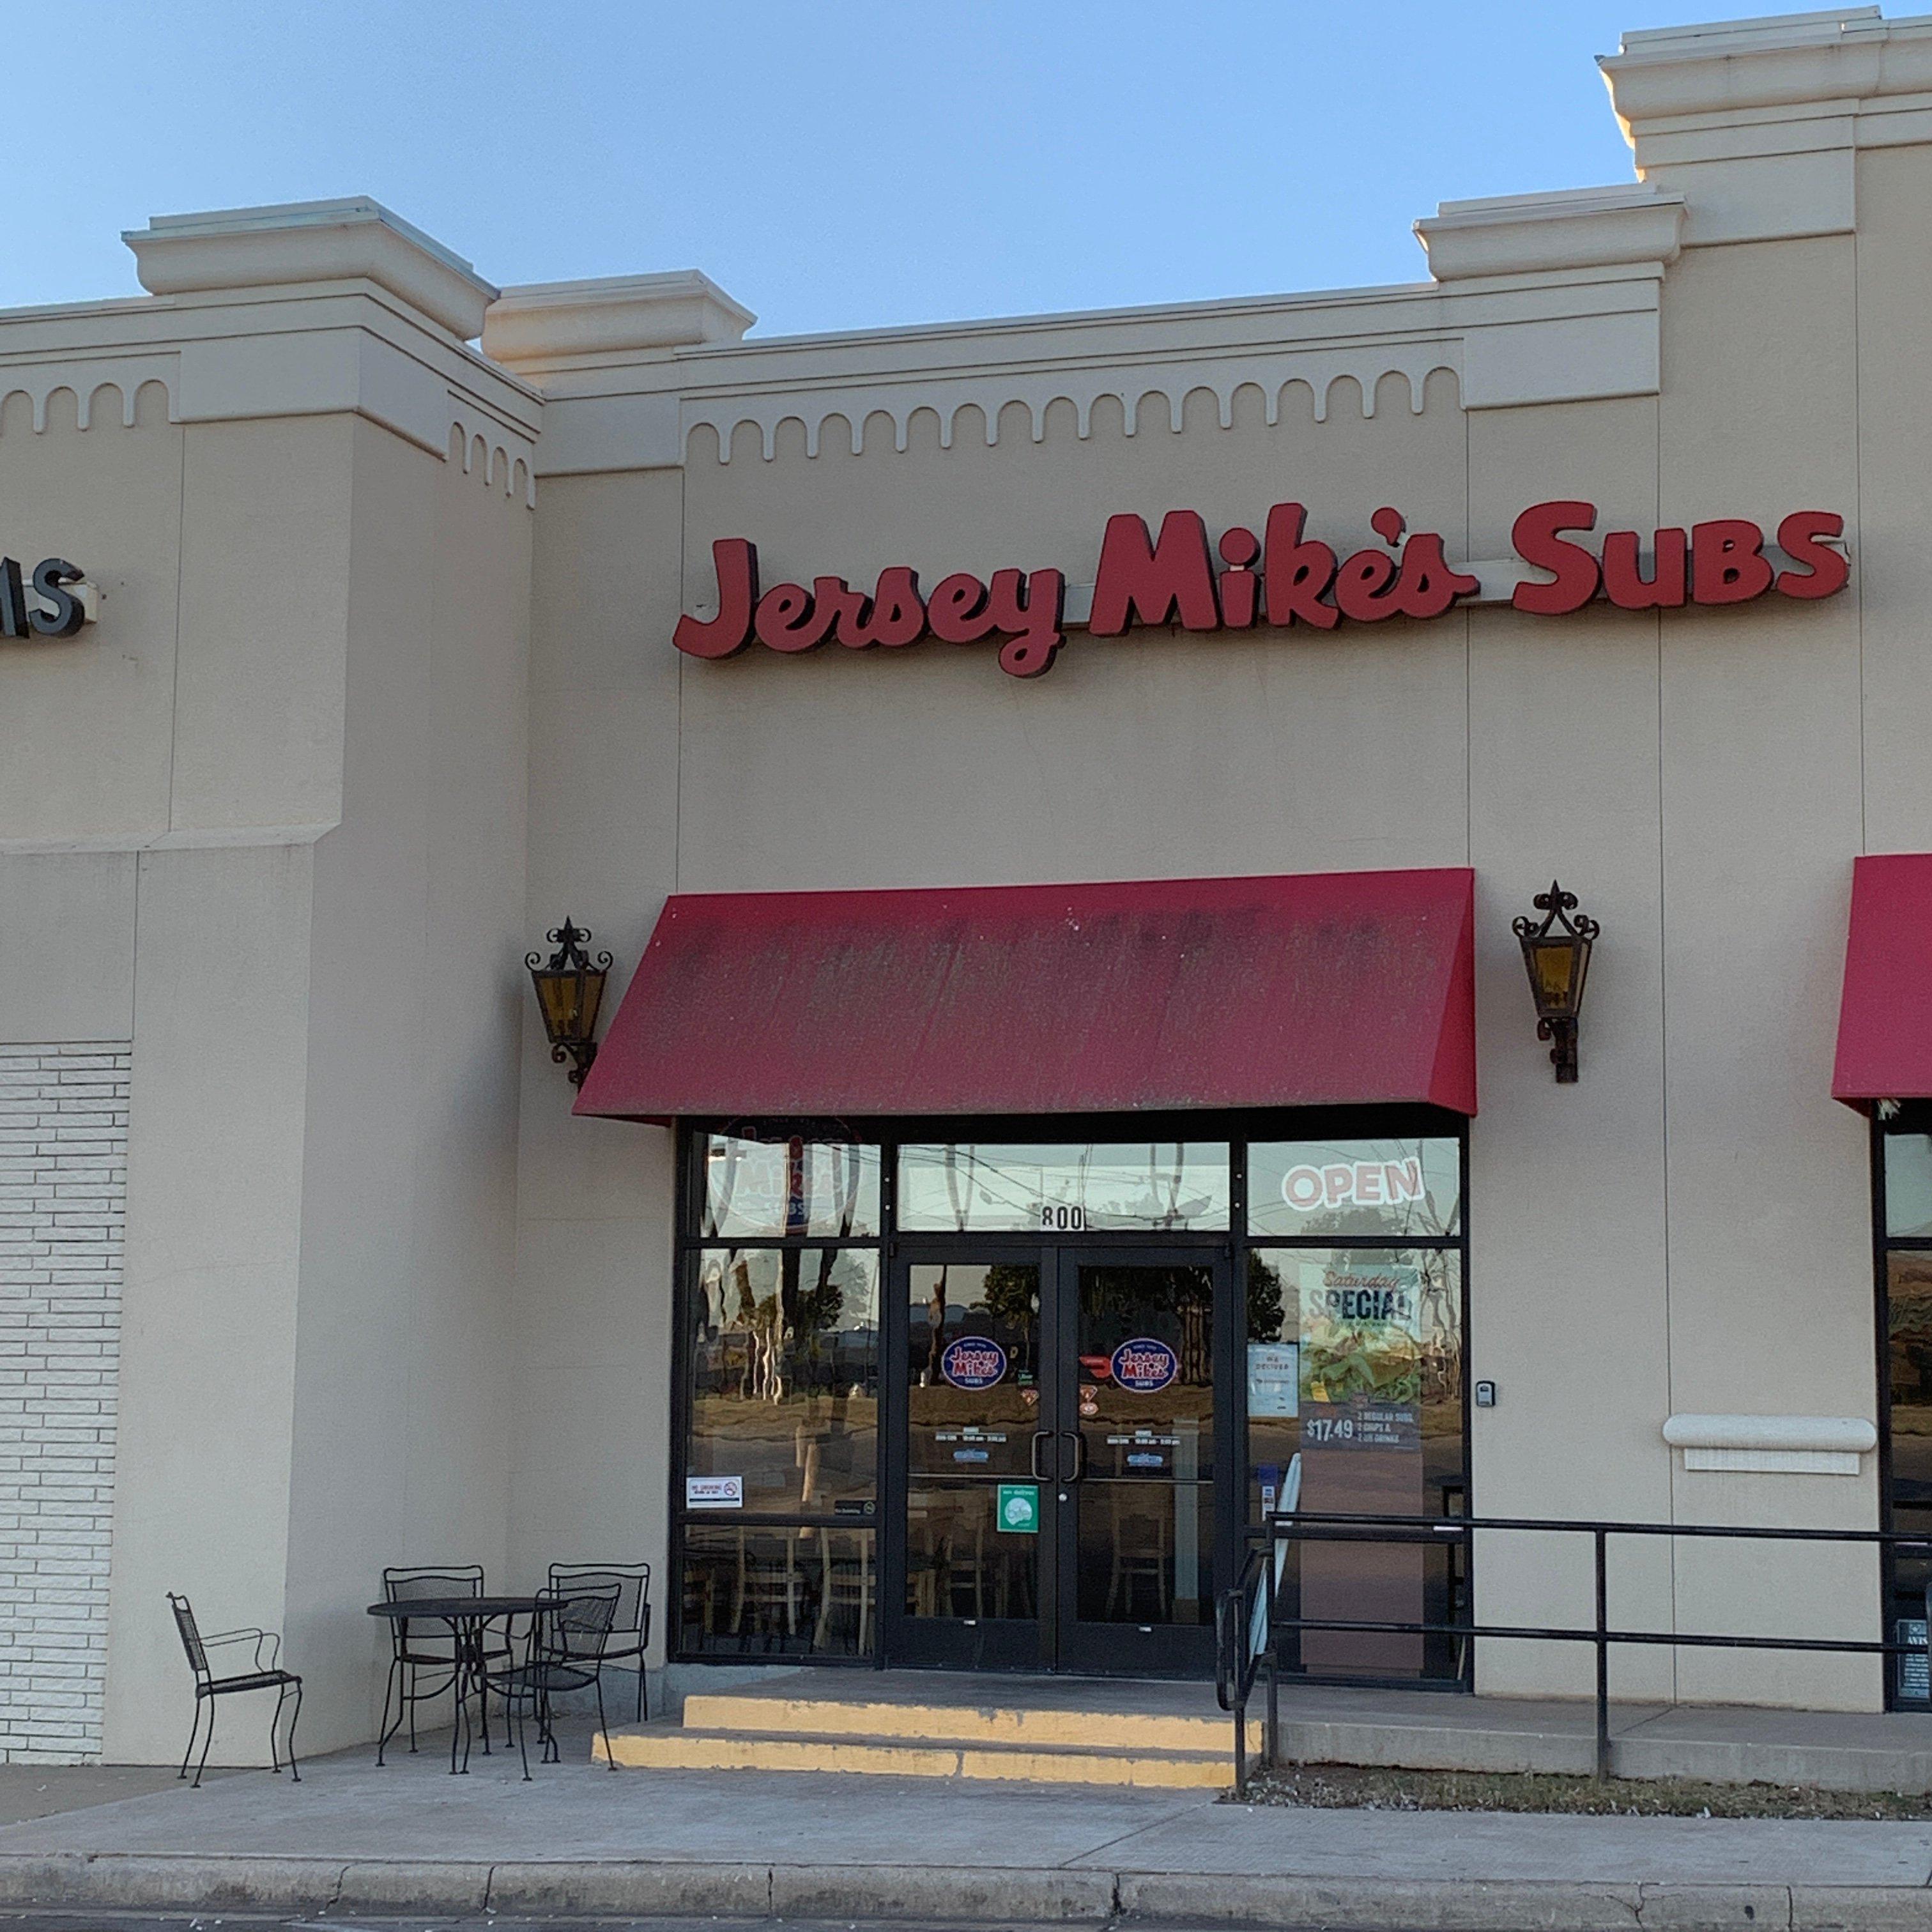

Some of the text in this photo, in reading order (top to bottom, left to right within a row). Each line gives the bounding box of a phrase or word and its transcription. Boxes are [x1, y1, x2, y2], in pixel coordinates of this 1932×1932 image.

[673, 538, 1067, 678] Jersey
[1089, 502, 1481, 638] Mike's
[1283, 1158, 1424, 1210] OPEN
[1041, 1206, 1082, 1230] 800
[949, 1346, 999, 1365] Jersey
[1118, 1348, 1169, 1367] Jersey
[1307, 1418, 1353, 1442] $17.49
